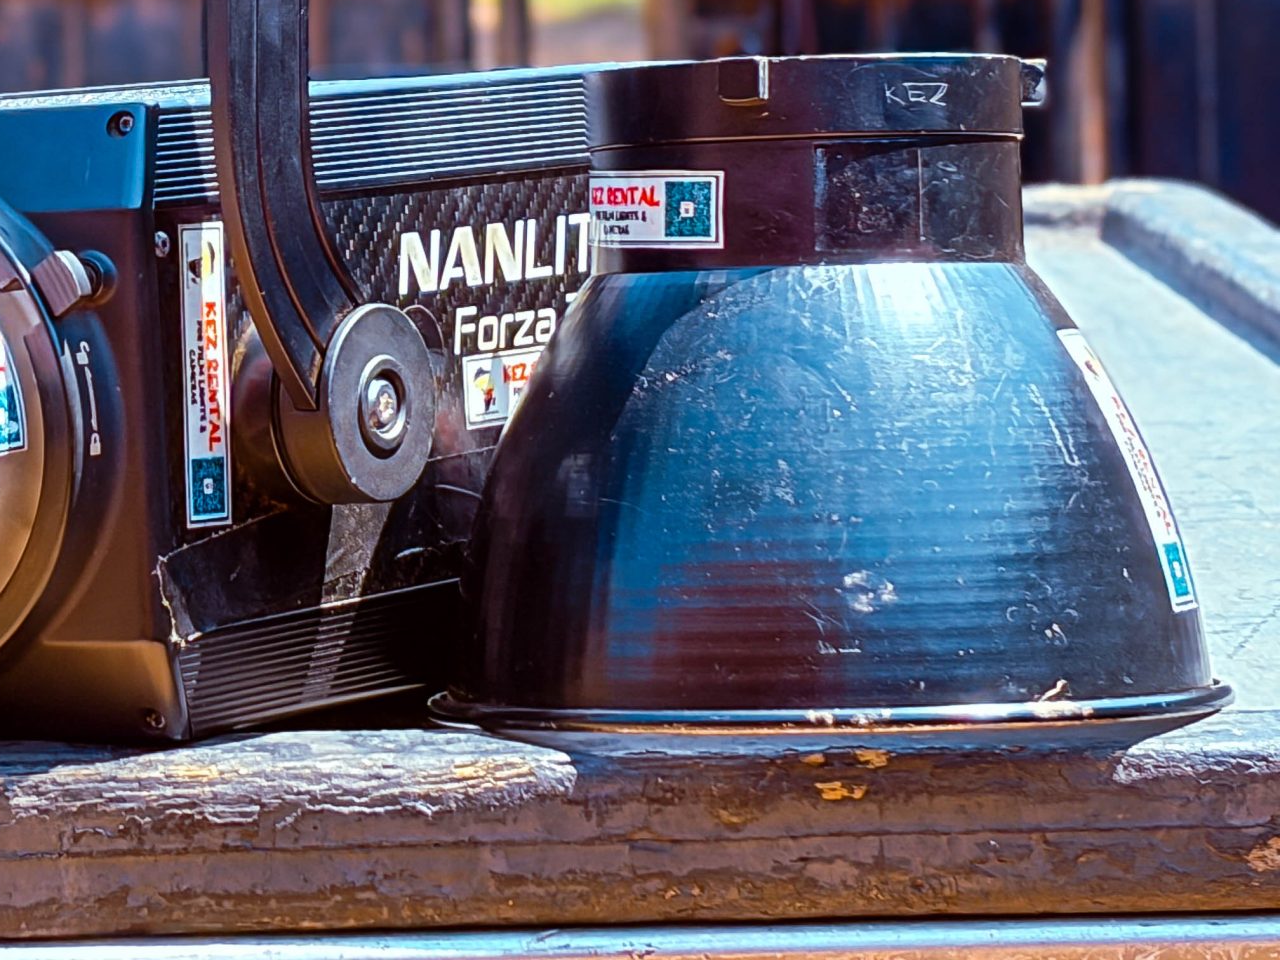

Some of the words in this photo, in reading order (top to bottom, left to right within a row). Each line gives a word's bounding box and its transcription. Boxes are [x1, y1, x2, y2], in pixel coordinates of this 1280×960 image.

[884, 82, 949, 107] KEZ
[607, 185, 661, 208] RENTAL
[399, 212, 592, 296] NANLIT
[205, 301, 218, 350] KEZ
[454, 306, 557, 356] Forza
[207, 358, 222, 452] RENTAL
